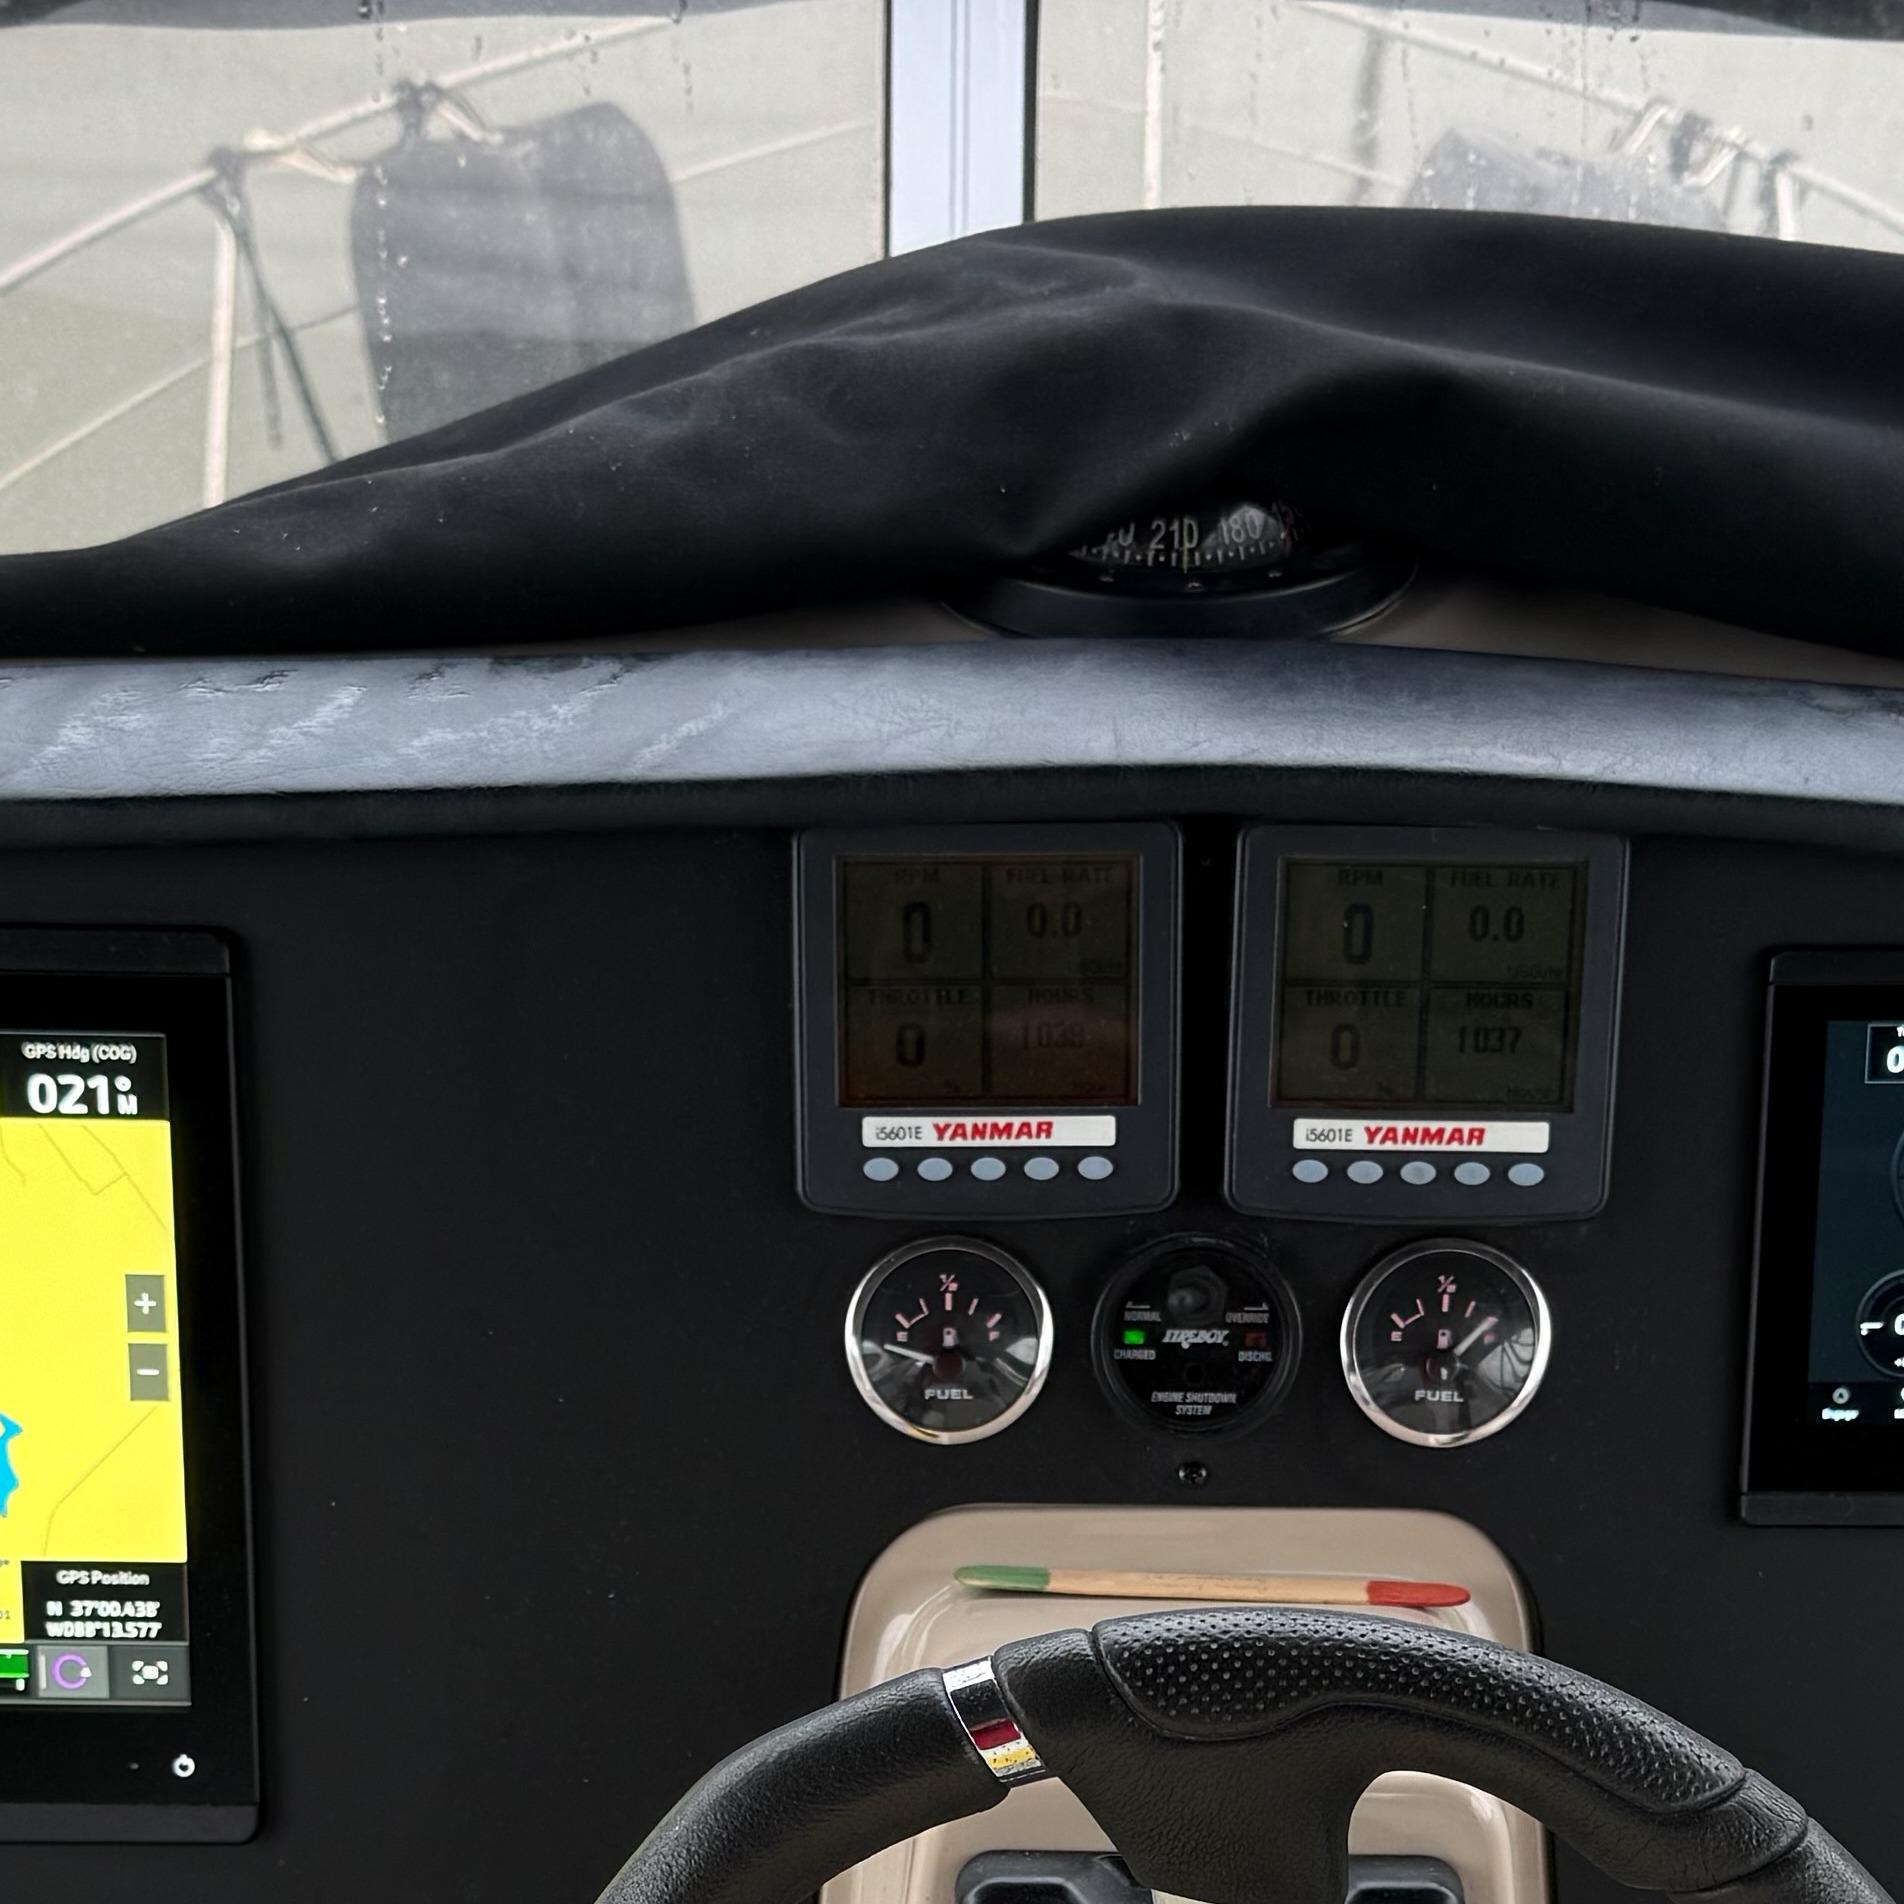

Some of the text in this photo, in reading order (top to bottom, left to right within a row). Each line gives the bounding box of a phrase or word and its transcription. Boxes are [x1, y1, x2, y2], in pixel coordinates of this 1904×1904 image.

[1027, 903, 1083, 936] 0.0
[1469, 905, 1525, 942] 0.0
[903, 901, 931, 963] 0
[1344, 903, 1374, 964] 0
[896, 1023, 926, 1067] 0
[1331, 1023, 1360, 1070] 0
[1458, 1026, 1522, 1053] 1037
[22, 1042, 137, 1064] GPS Hdg (COG)
[933, 1122, 1053, 1141] YANMAR
[1305, 1126, 1486, 1146] i5601E YANMAR
[1161, 1329, 1229, 1349] FIREBOY
[924, 1388, 973, 1400] FUEL
[1414, 1389, 1464, 1402] FUEL
[1175, 1405, 1212, 1415] SYSTEM
[56, 1570, 150, 1585] GPS Position
